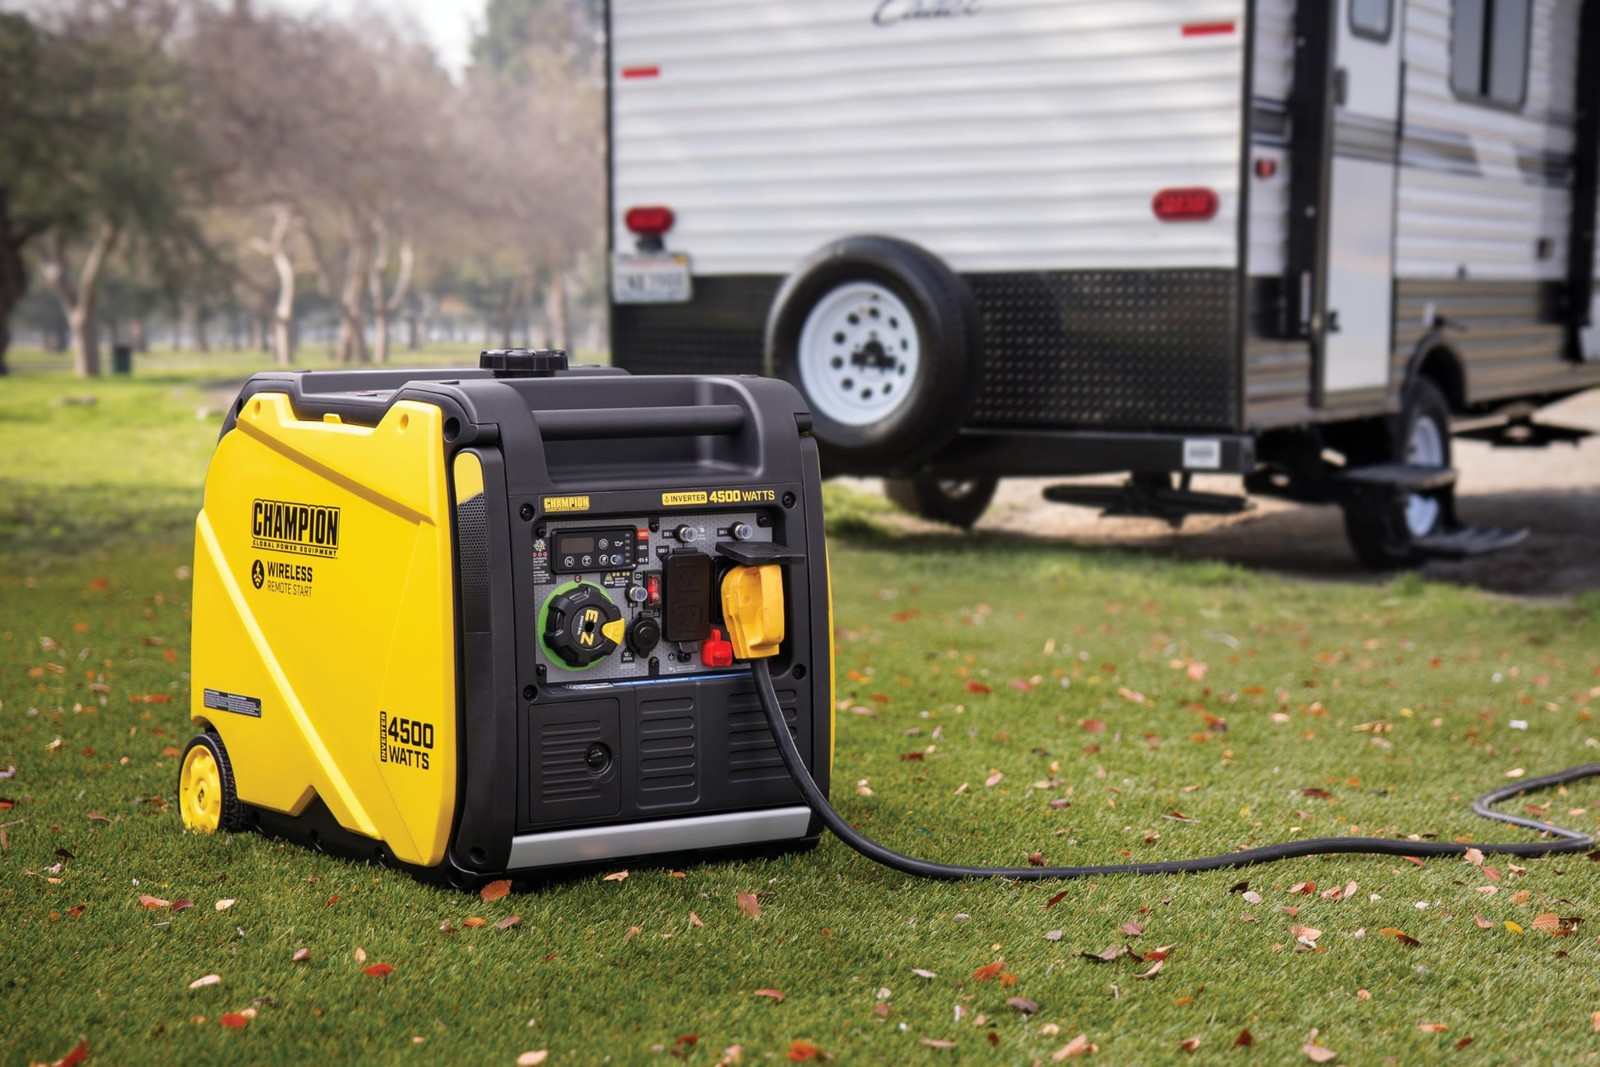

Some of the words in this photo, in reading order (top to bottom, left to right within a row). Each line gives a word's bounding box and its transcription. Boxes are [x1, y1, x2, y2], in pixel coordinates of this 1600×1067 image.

[543, 496, 590, 510] CHAMPION
[670, 494, 706, 503] INVERTER
[709, 490, 741, 503] 4500
[741, 490, 776, 502] WATTS
[253, 502, 339, 546] CHAMPION
[252, 540, 275, 549] GLOBAL
[276, 543, 298, 552] POWER
[299, 546, 338, 557] EQUIPMENT
[267, 561, 313, 583] WIRELESS
[267, 581, 293, 595] REMOTE
[292, 584, 313, 597] START
[388, 716, 434, 750] 4500
[388, 745, 430, 770] WATTS
